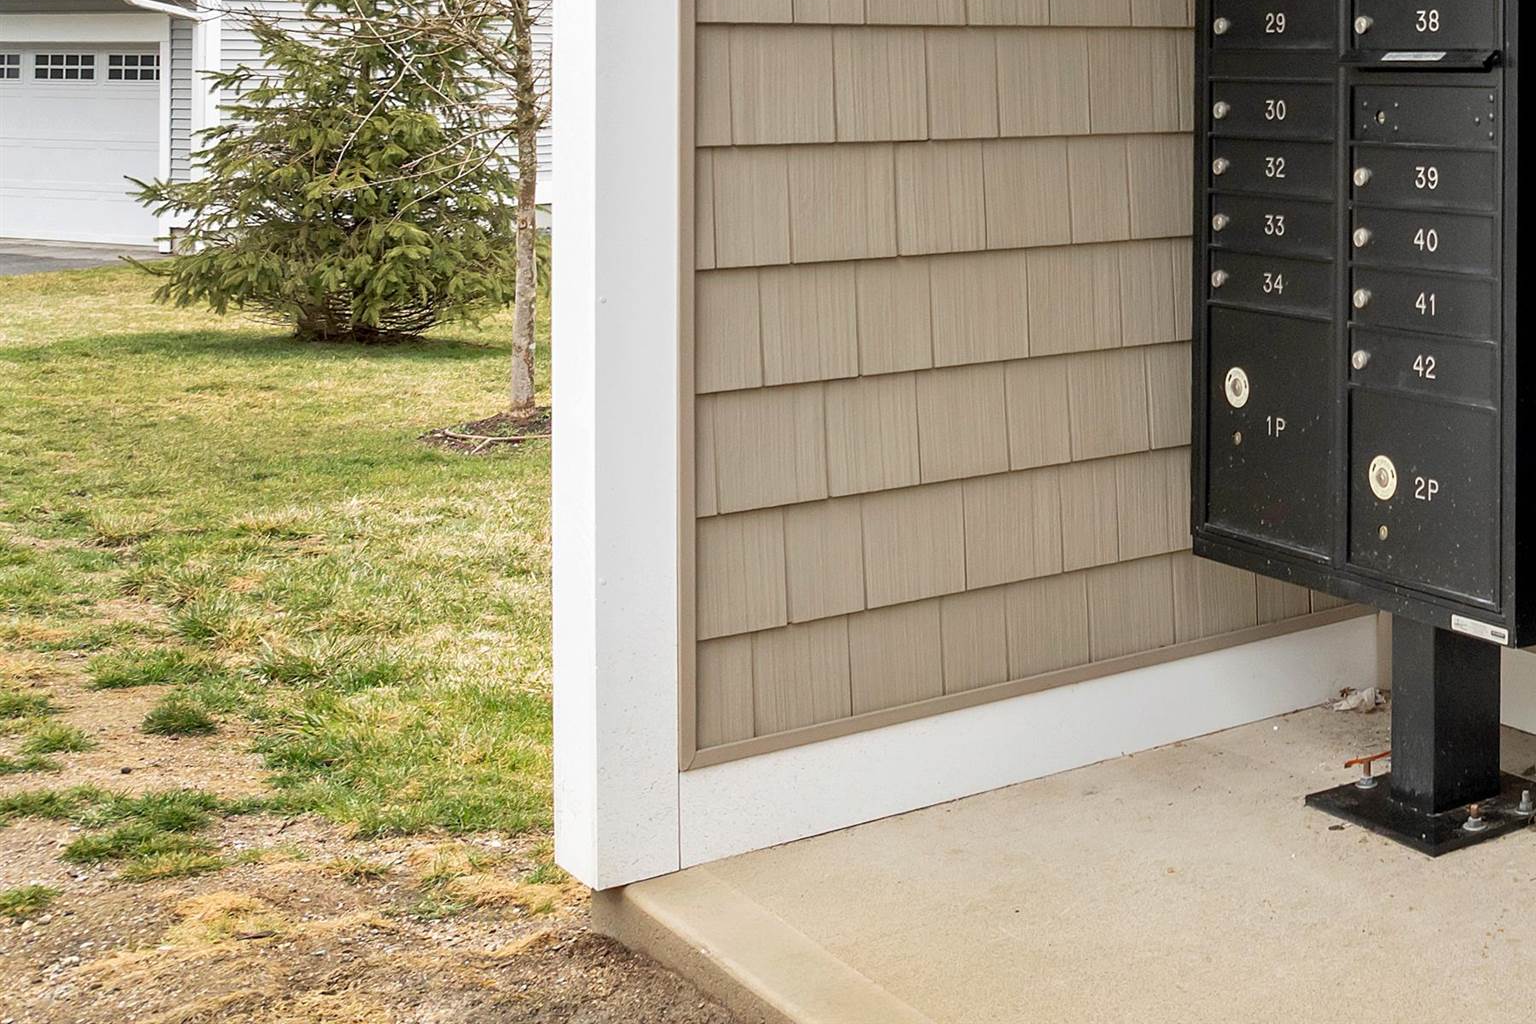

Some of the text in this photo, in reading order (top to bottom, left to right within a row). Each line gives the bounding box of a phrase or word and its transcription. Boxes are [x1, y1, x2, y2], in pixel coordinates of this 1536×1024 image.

[1265, 12, 1286, 33] 29
[1415, 9, 1440, 32] 38
[1265, 99, 1286, 121] 30
[1265, 157, 1286, 178] 32
[1414, 166, 1439, 190] 39
[1264, 214, 1285, 236] 33
[1413, 228, 1438, 253] 40
[1262, 272, 1284, 295] 34
[1415, 292, 1436, 316] 41
[1412, 354, 1436, 380] 42
[1266, 415, 1286, 438] 1P
[1413, 476, 1440, 502] 2P
